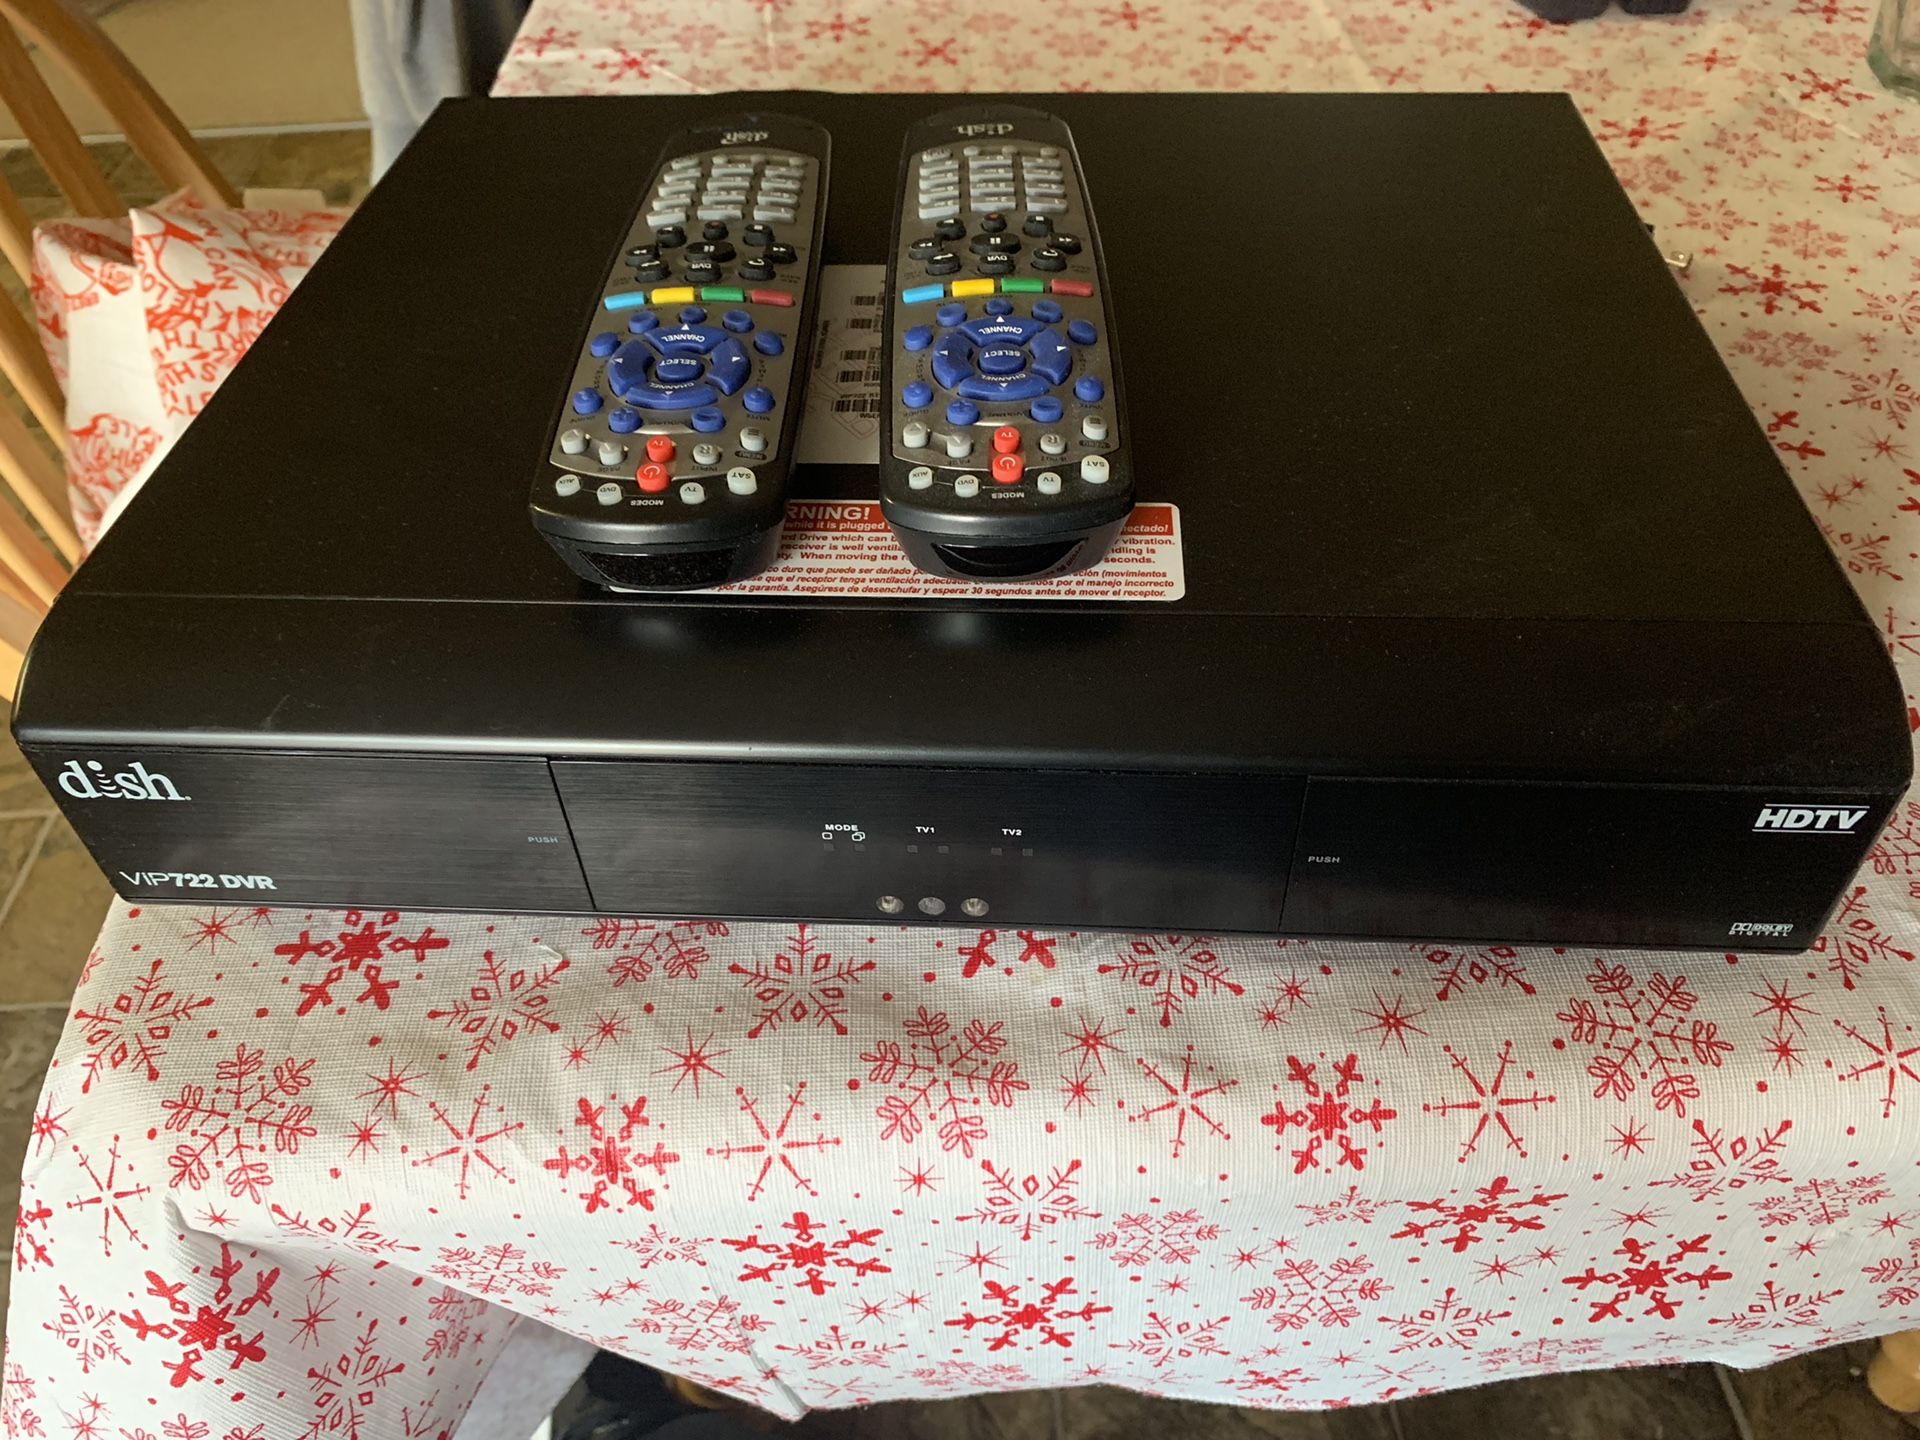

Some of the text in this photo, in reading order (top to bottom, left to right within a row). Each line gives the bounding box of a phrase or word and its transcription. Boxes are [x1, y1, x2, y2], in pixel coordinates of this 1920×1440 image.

[978, 325, 1023, 335] CHANNEL
[661, 333, 706, 343] CHANNEL
[983, 350, 1021, 358] SELECT
[659, 357, 697, 366] SELECT
[980, 373, 1026, 384] CHANNEL
[648, 381, 695, 393] CHANNEL
[1000, 431, 1014, 439] TV
[1085, 460, 1105, 468] SAT
[731, 471, 752, 480] SAT
[600, 485, 617, 494] DVD
[685, 486, 698, 494] TV
[991, 491, 1025, 499] MODES
[786, 506, 870, 520] RNING!
[839, 521, 885, 531] plugged
[800, 533, 828, 541] Drive
[842, 543, 864, 551] well
[800, 552, 832, 560] When
[835, 553, 877, 561] moving
[1103, 556, 1155, 564] seconds.
[825, 566, 856, 575] puede
[875, 567, 911, 575] dañado
[1101, 570, 1168, 579] (movimientos
[796, 575, 837, 583] receptor
[839, 576, 866, 584] tenga
[868, 576, 920, 584] ventilación
[1087, 580, 1122, 588] manejo
[748, 584, 790, 592] garantía.
[792, 584, 845, 593] Asegúrese
[847, 585, 859, 593] de
[861, 585, 921, 593] desenchufar
[923, 587, 931, 595] y
[932, 588, 969, 596] esperar
[985, 588, 1032, 597] segundos
[1123, 589, 1166, 598] receptor.
[58, 760, 191, 801] dish
[1754, 808, 1867, 830] HDTV
[825, 823, 859, 832] MODE
[915, 826, 935, 834] TV1
[1001, 828, 1022, 836] TV2
[1308, 855, 1340, 863] PUSH
[219, 874, 278, 890] DVR
